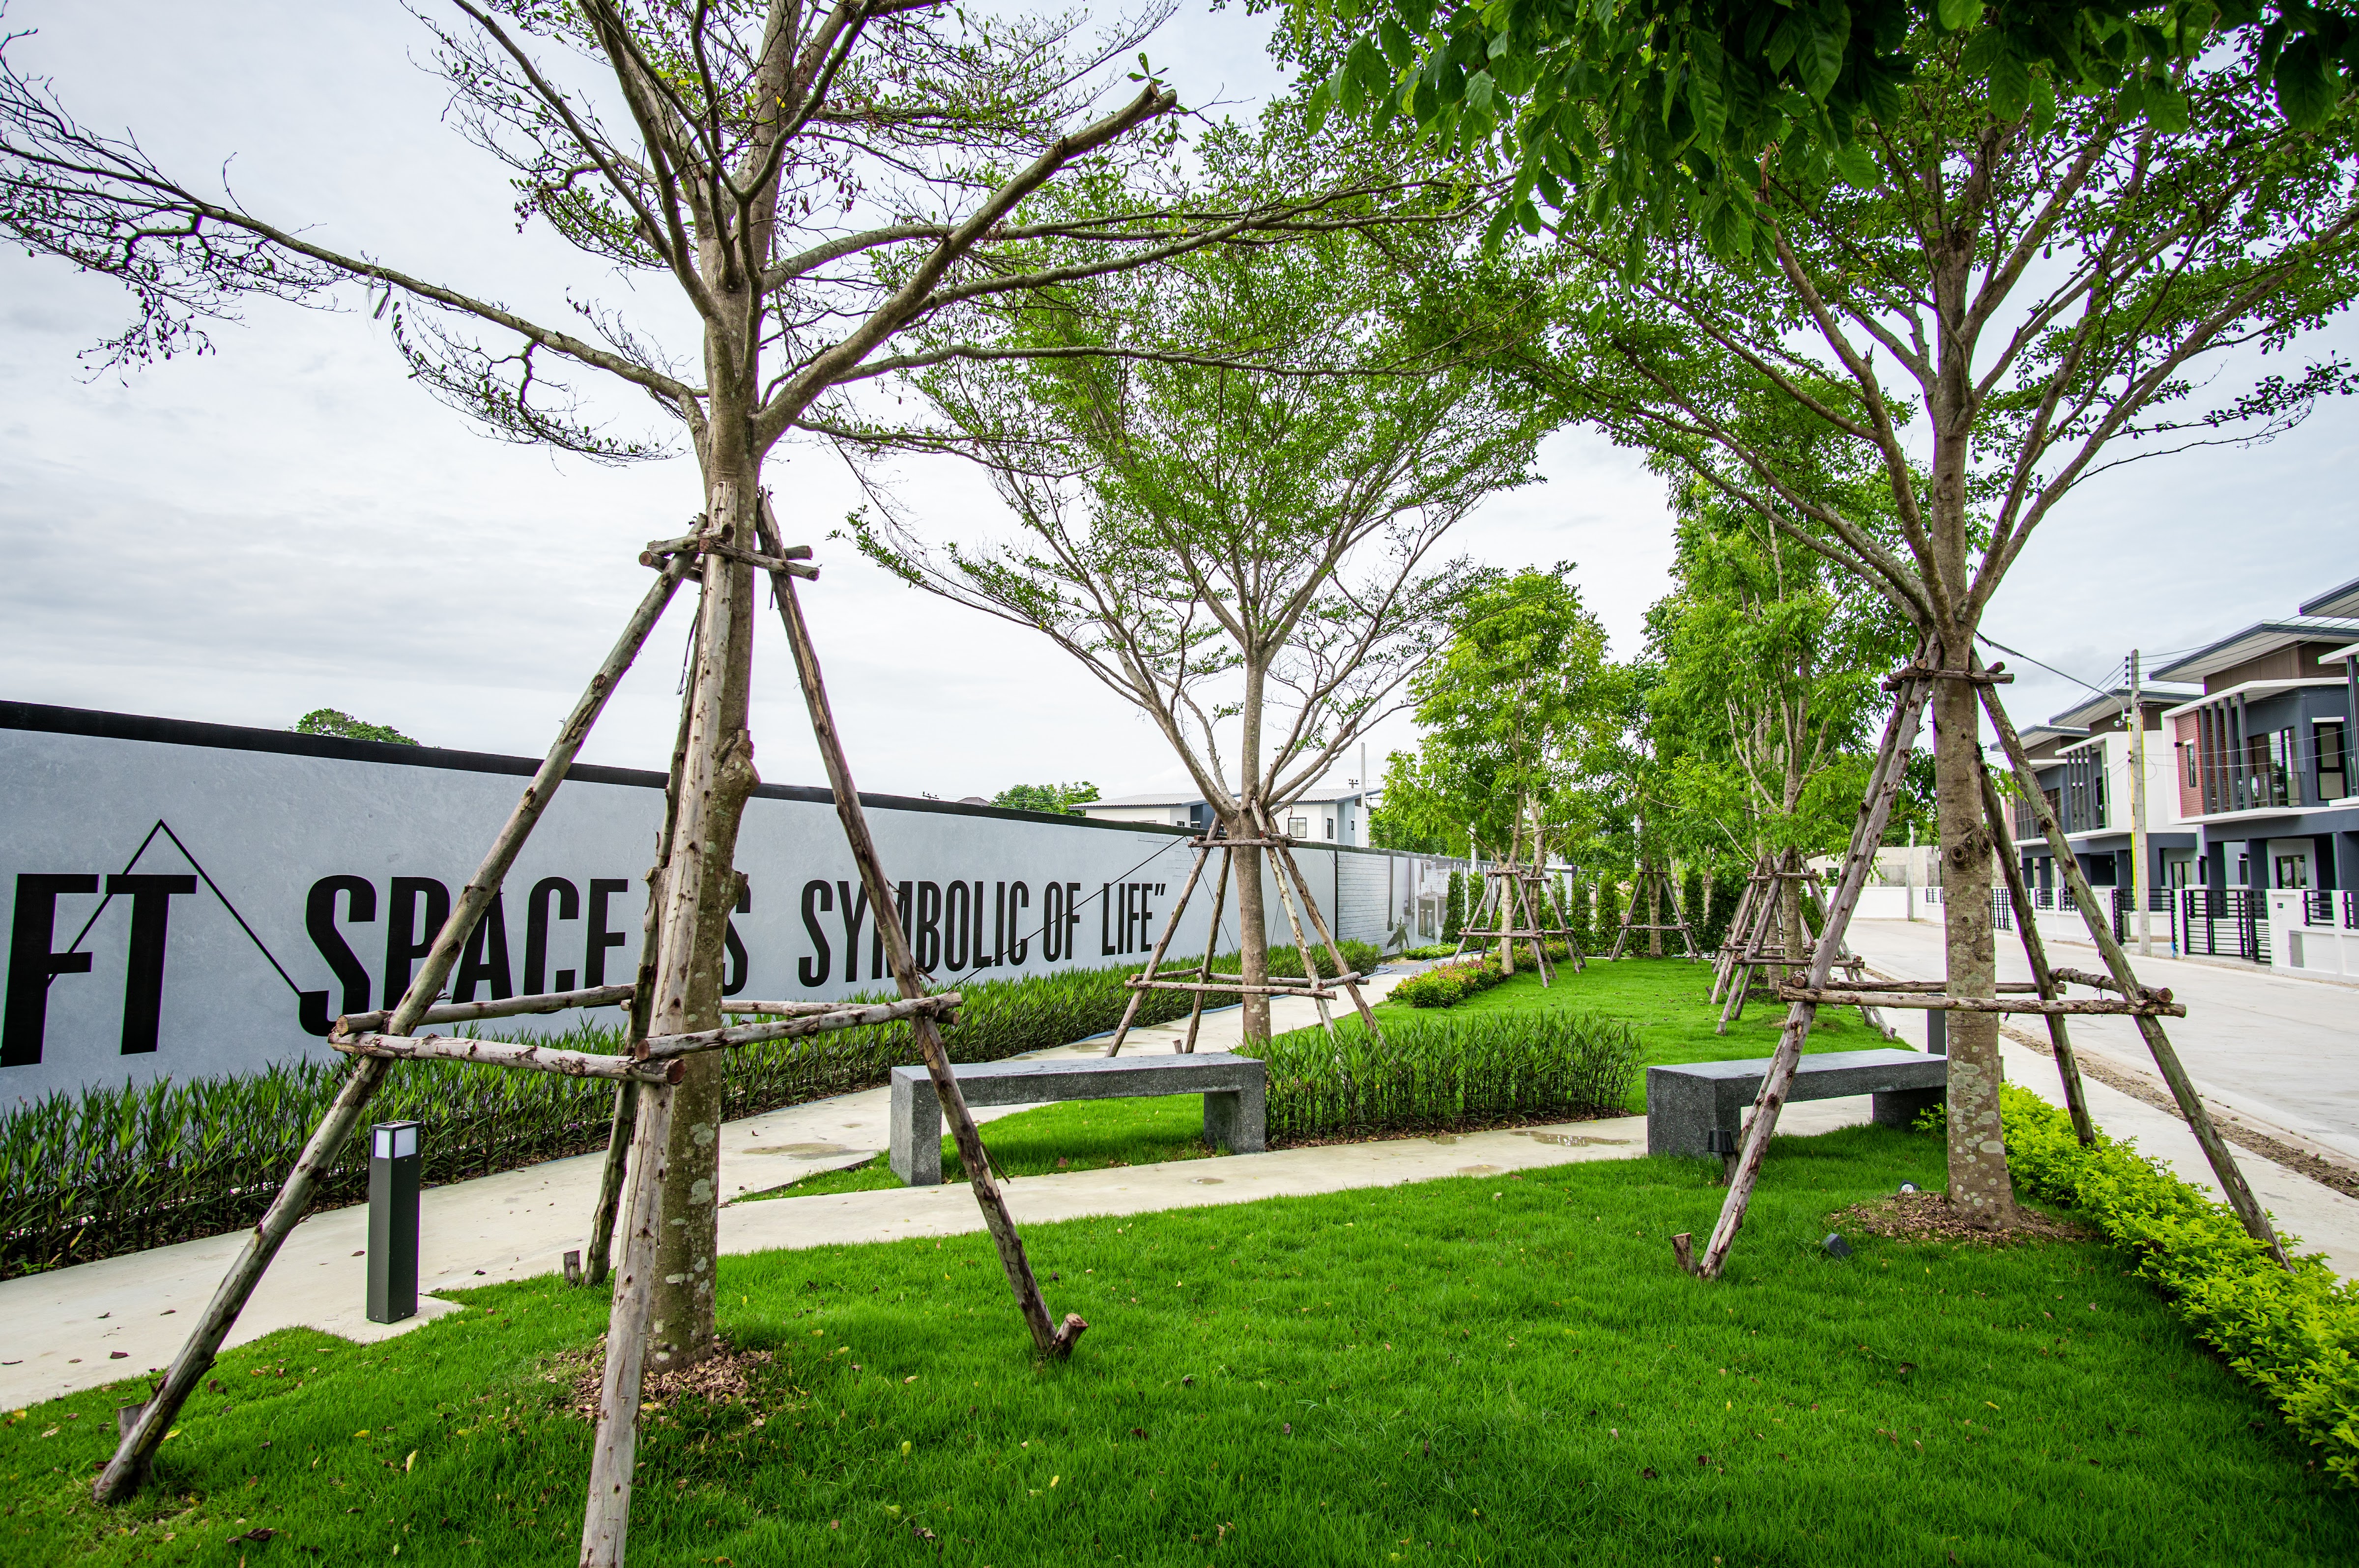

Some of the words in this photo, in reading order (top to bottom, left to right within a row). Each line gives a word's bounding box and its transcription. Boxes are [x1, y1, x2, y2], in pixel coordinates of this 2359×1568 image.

[299, 875, 629, 1037] SPACE
[798, 879, 1030, 988] SYMBOLIC
[1043, 881, 1081, 962] OF
